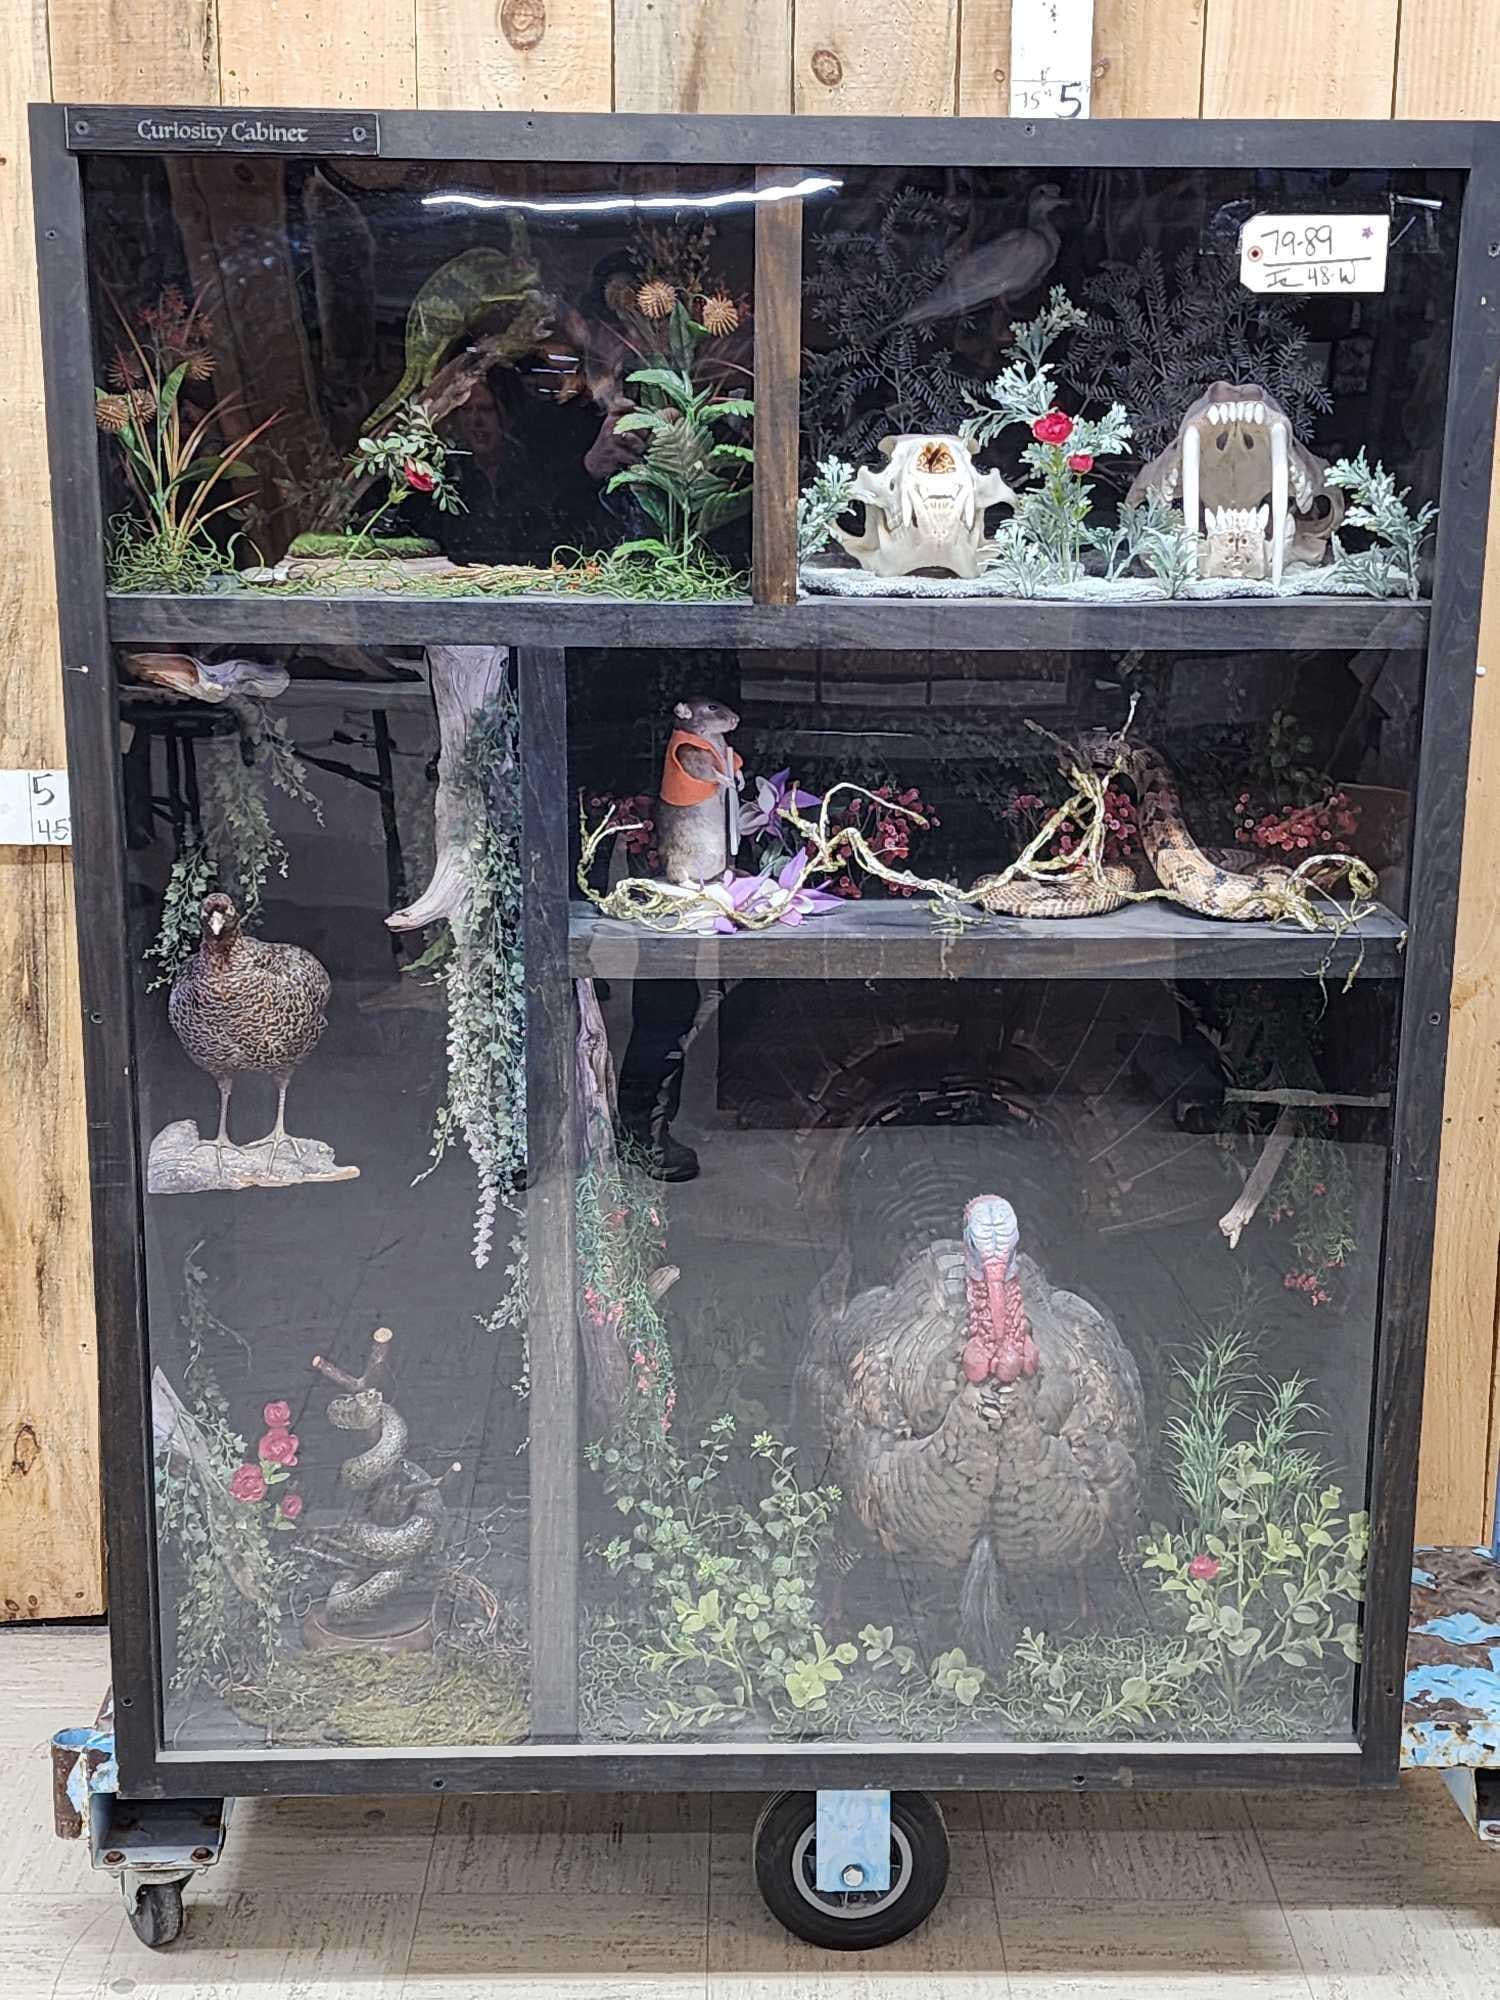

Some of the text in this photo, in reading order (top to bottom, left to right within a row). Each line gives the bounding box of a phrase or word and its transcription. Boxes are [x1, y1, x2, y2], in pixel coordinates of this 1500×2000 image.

[136, 118, 309, 147] Curiosity Cabinet
[1260, 225, 1332, 256] 79-89
[32, 773, 55, 806] 5
